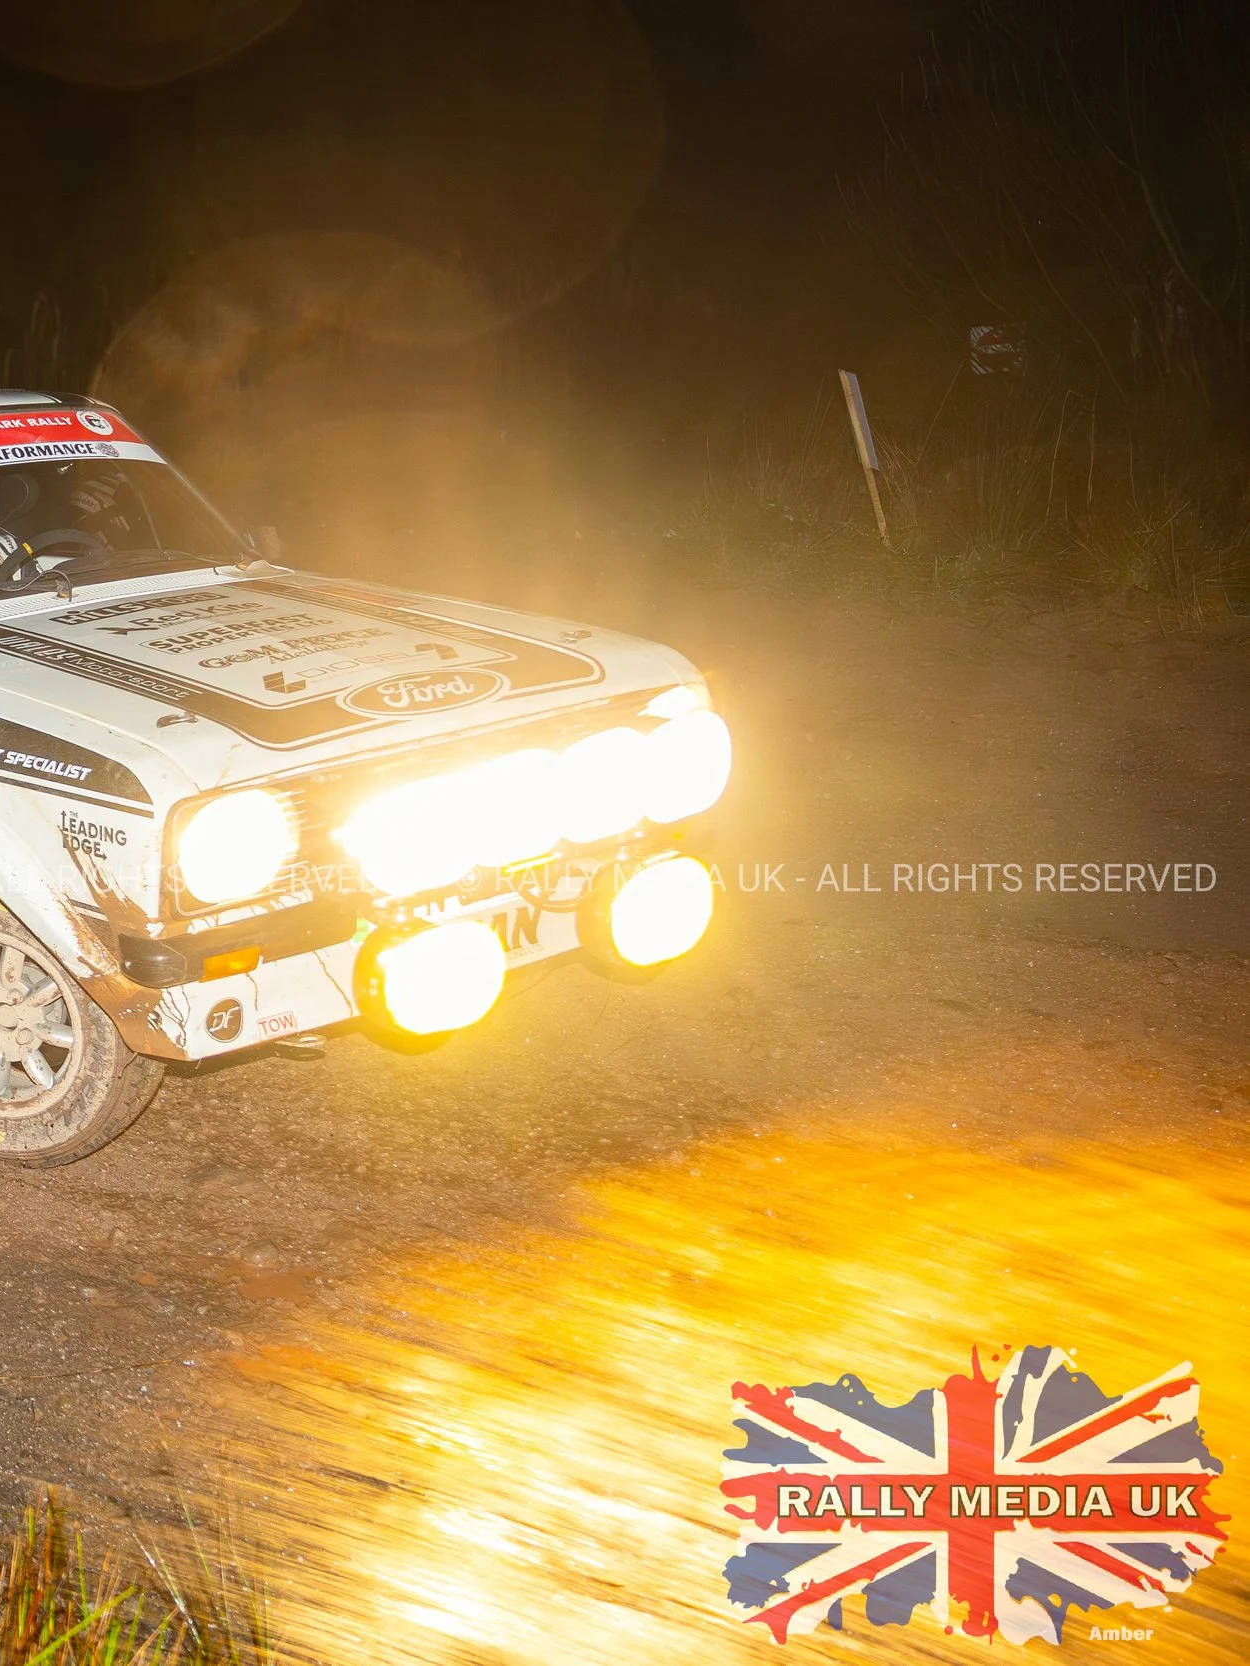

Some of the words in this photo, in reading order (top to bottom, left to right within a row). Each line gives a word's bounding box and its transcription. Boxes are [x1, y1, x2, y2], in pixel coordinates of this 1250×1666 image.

[25, 416, 73, 427] RALLY
[128, 609, 199, 627] Red
[148, 613, 314, 649] SUPERFAST
[171, 624, 295, 654] PROPERTIES
[299, 618, 335, 628] LTD
[72, 656, 190, 699] Motorsport
[376, 675, 476, 708] Ford
[3, 750, 93, 781] SPECIALIST
[61, 811, 127, 846] LEADING
[69, 810, 79, 819] THE
[62, 832, 105, 859] EDGE
[258, 1014, 294, 1035] TOW
